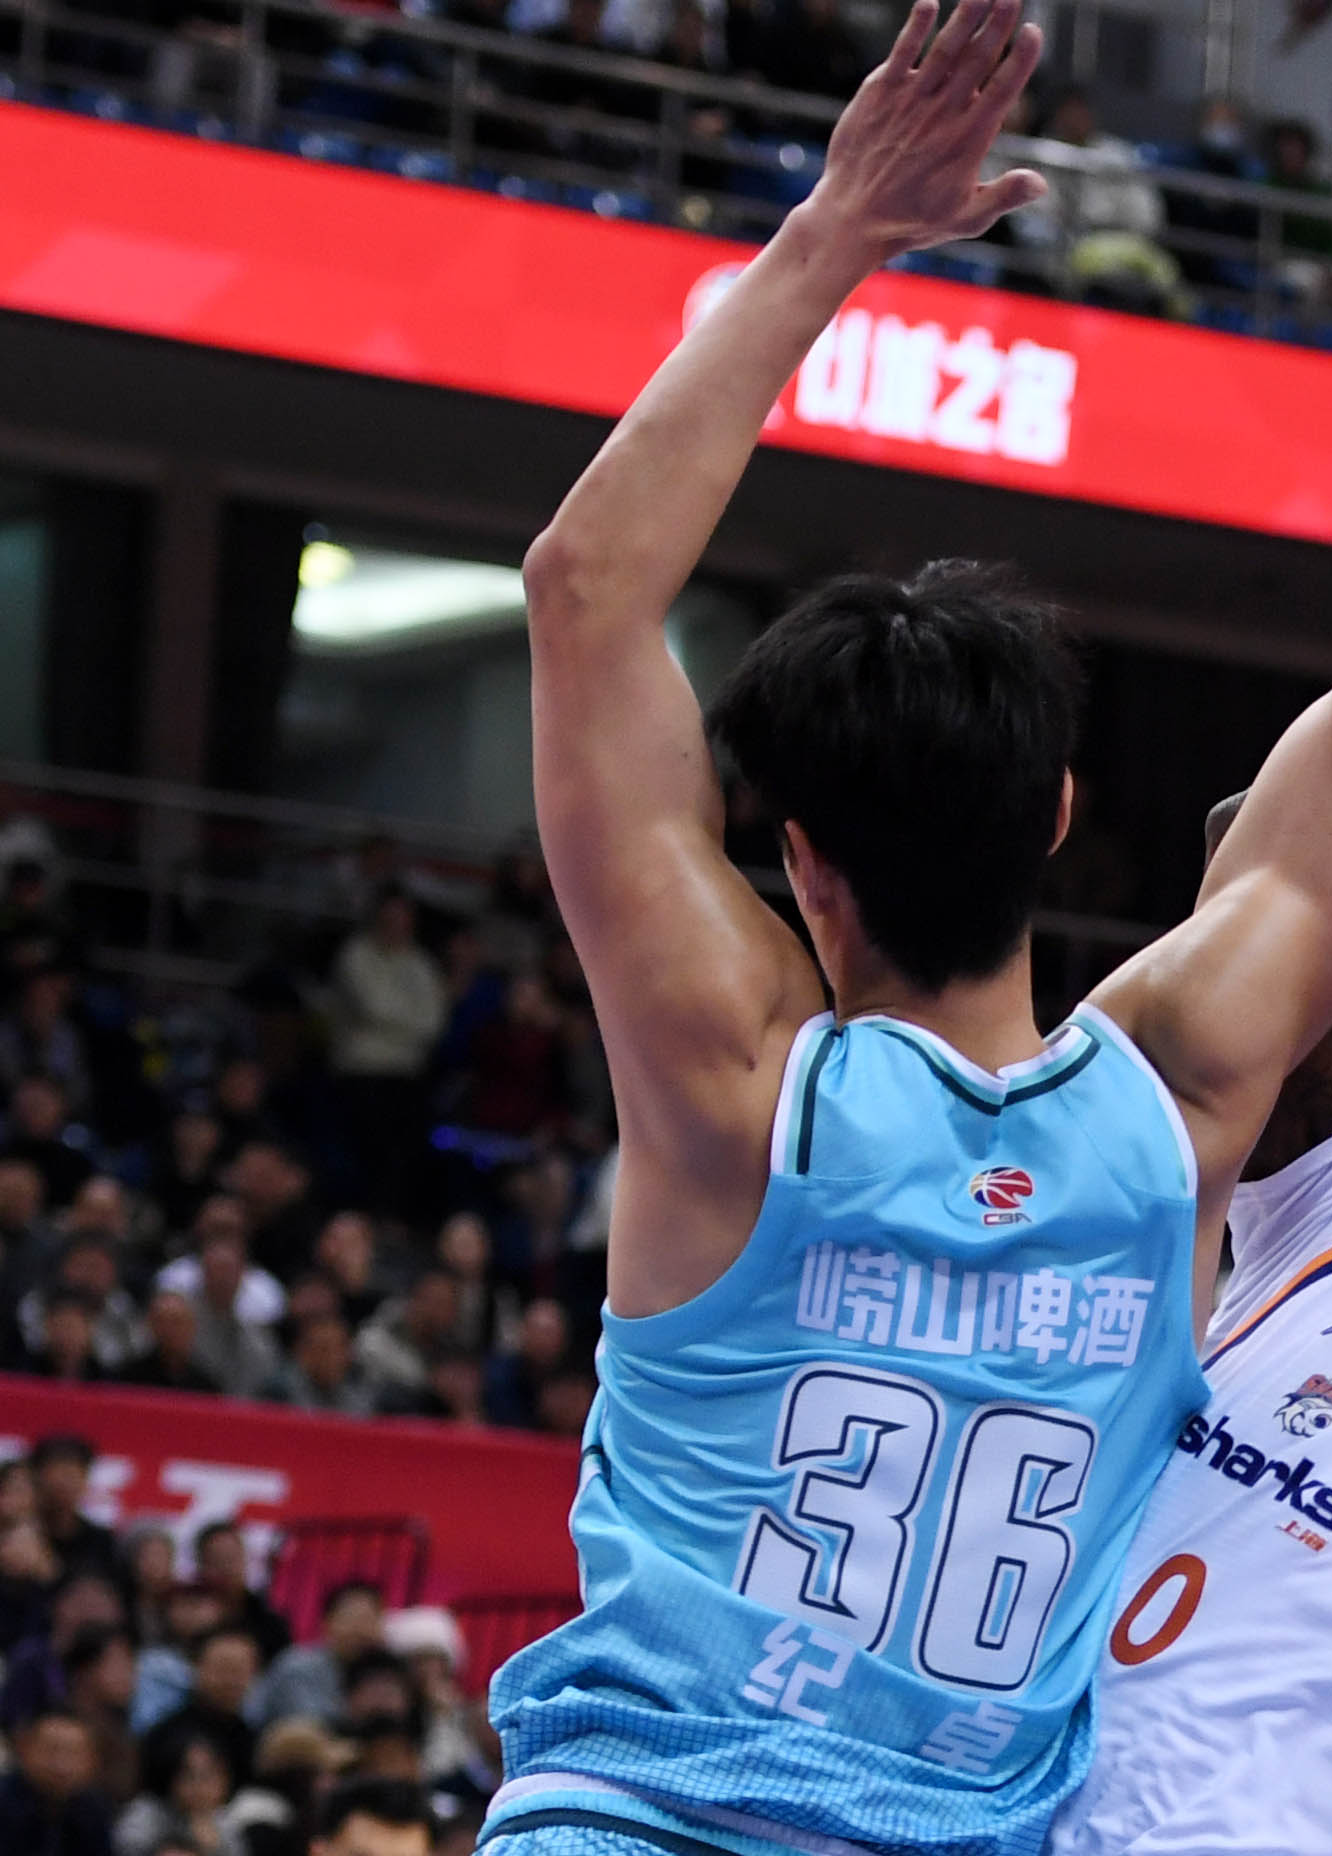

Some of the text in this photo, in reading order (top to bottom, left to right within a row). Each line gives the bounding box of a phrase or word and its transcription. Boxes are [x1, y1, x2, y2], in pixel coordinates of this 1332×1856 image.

[796, 1239, 1155, 1367] 崂山啤酒
[732, 1361, 1098, 1697] 36
[1110, 1553, 1207, 1665] 0
